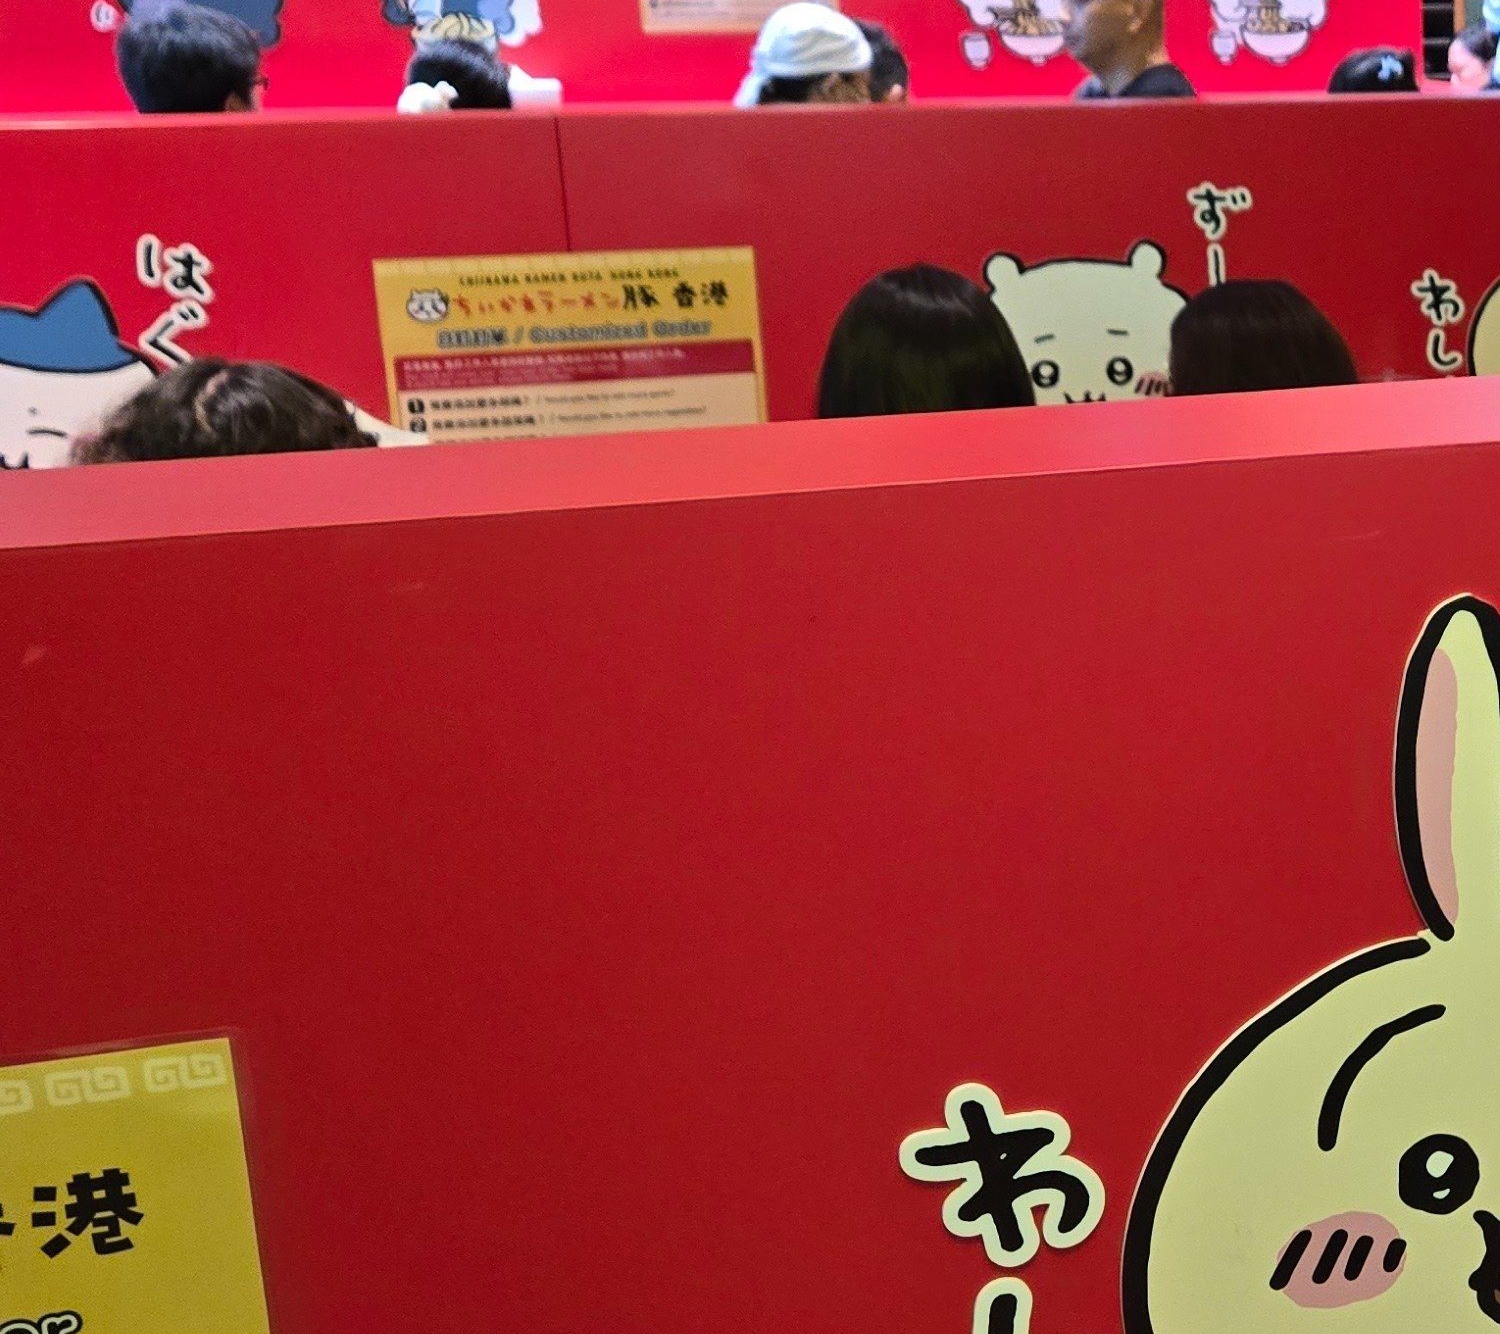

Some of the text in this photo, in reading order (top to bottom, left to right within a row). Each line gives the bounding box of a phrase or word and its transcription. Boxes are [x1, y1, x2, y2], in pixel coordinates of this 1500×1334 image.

[1192, 187, 1248, 285] ずー
[143, 241, 206, 365] はぐ
[1416, 275, 1461, 366] わし
